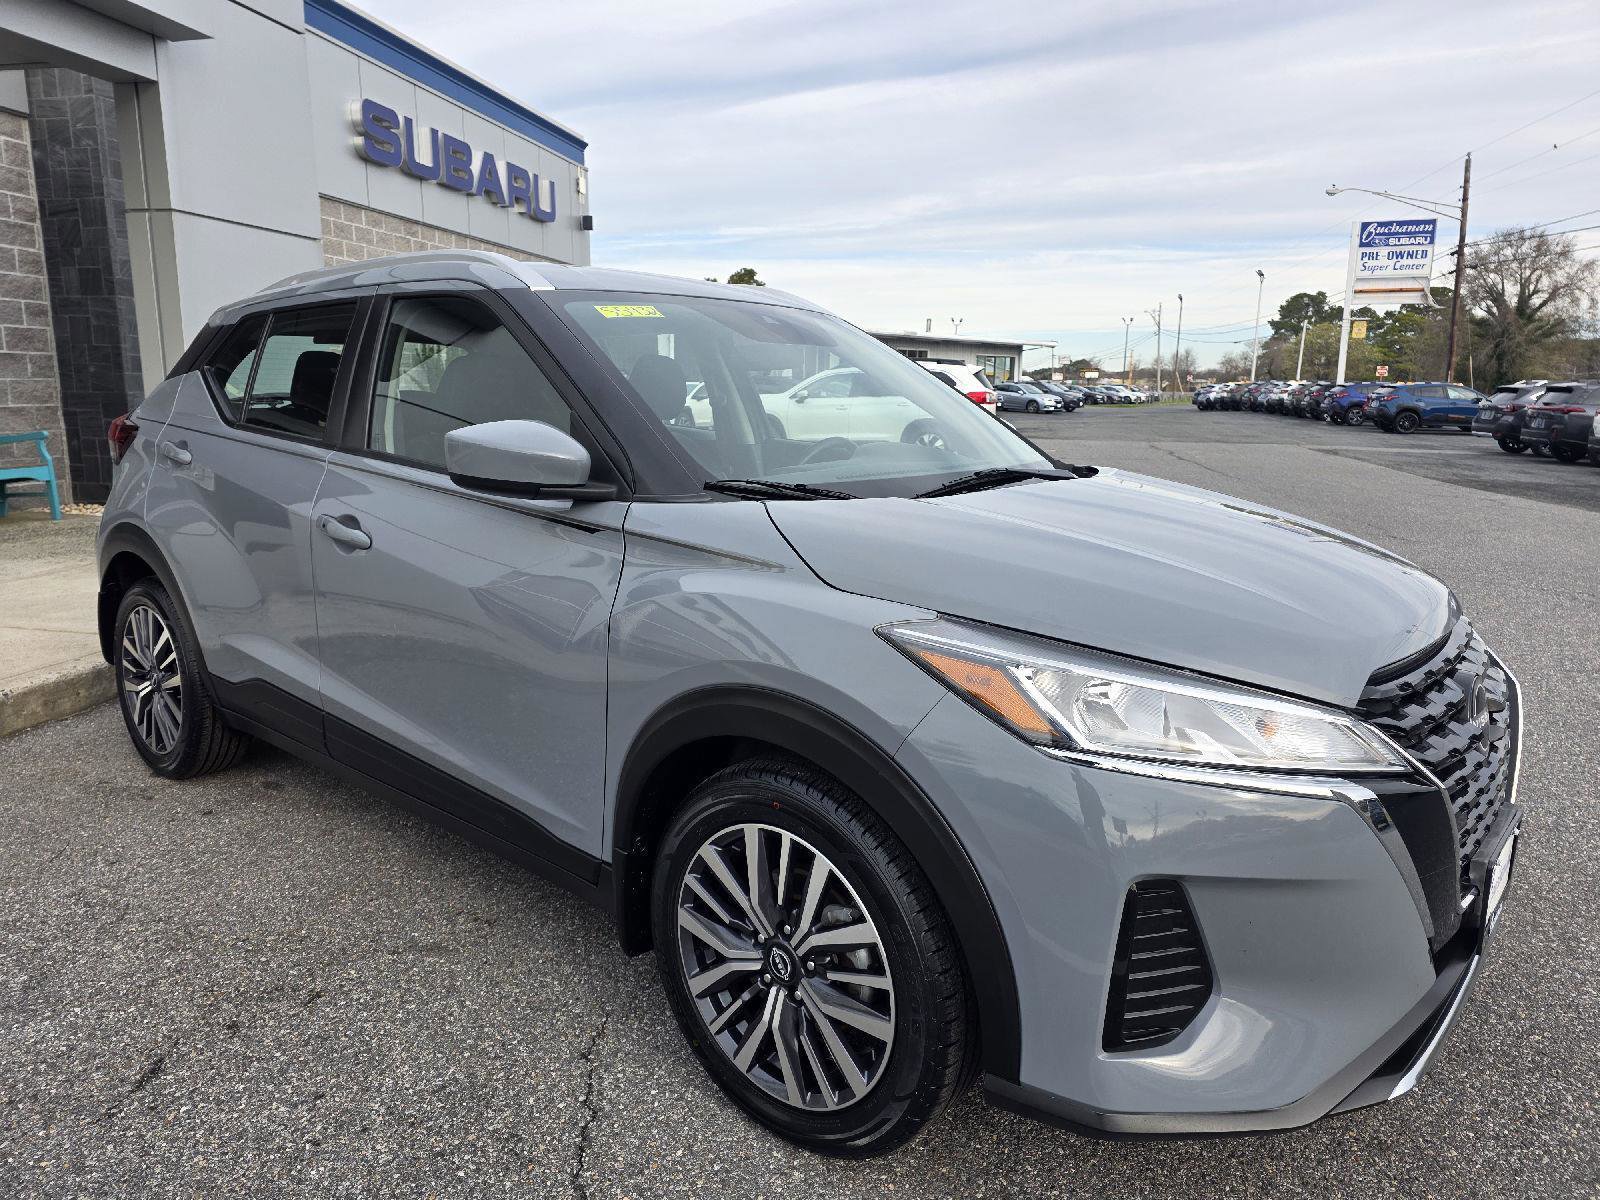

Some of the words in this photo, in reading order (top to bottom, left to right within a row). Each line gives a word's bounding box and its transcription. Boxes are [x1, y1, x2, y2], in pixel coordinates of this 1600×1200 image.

[360, 97, 556, 223] SUBARU
[1362, 222, 1434, 243] Buchanan
[1388, 236, 1430, 245] SUBARU
[1361, 249, 1428, 261] PRE-OWNED
[1360, 262, 1390, 274] Super
[1393, 261, 1426, 271] Center
